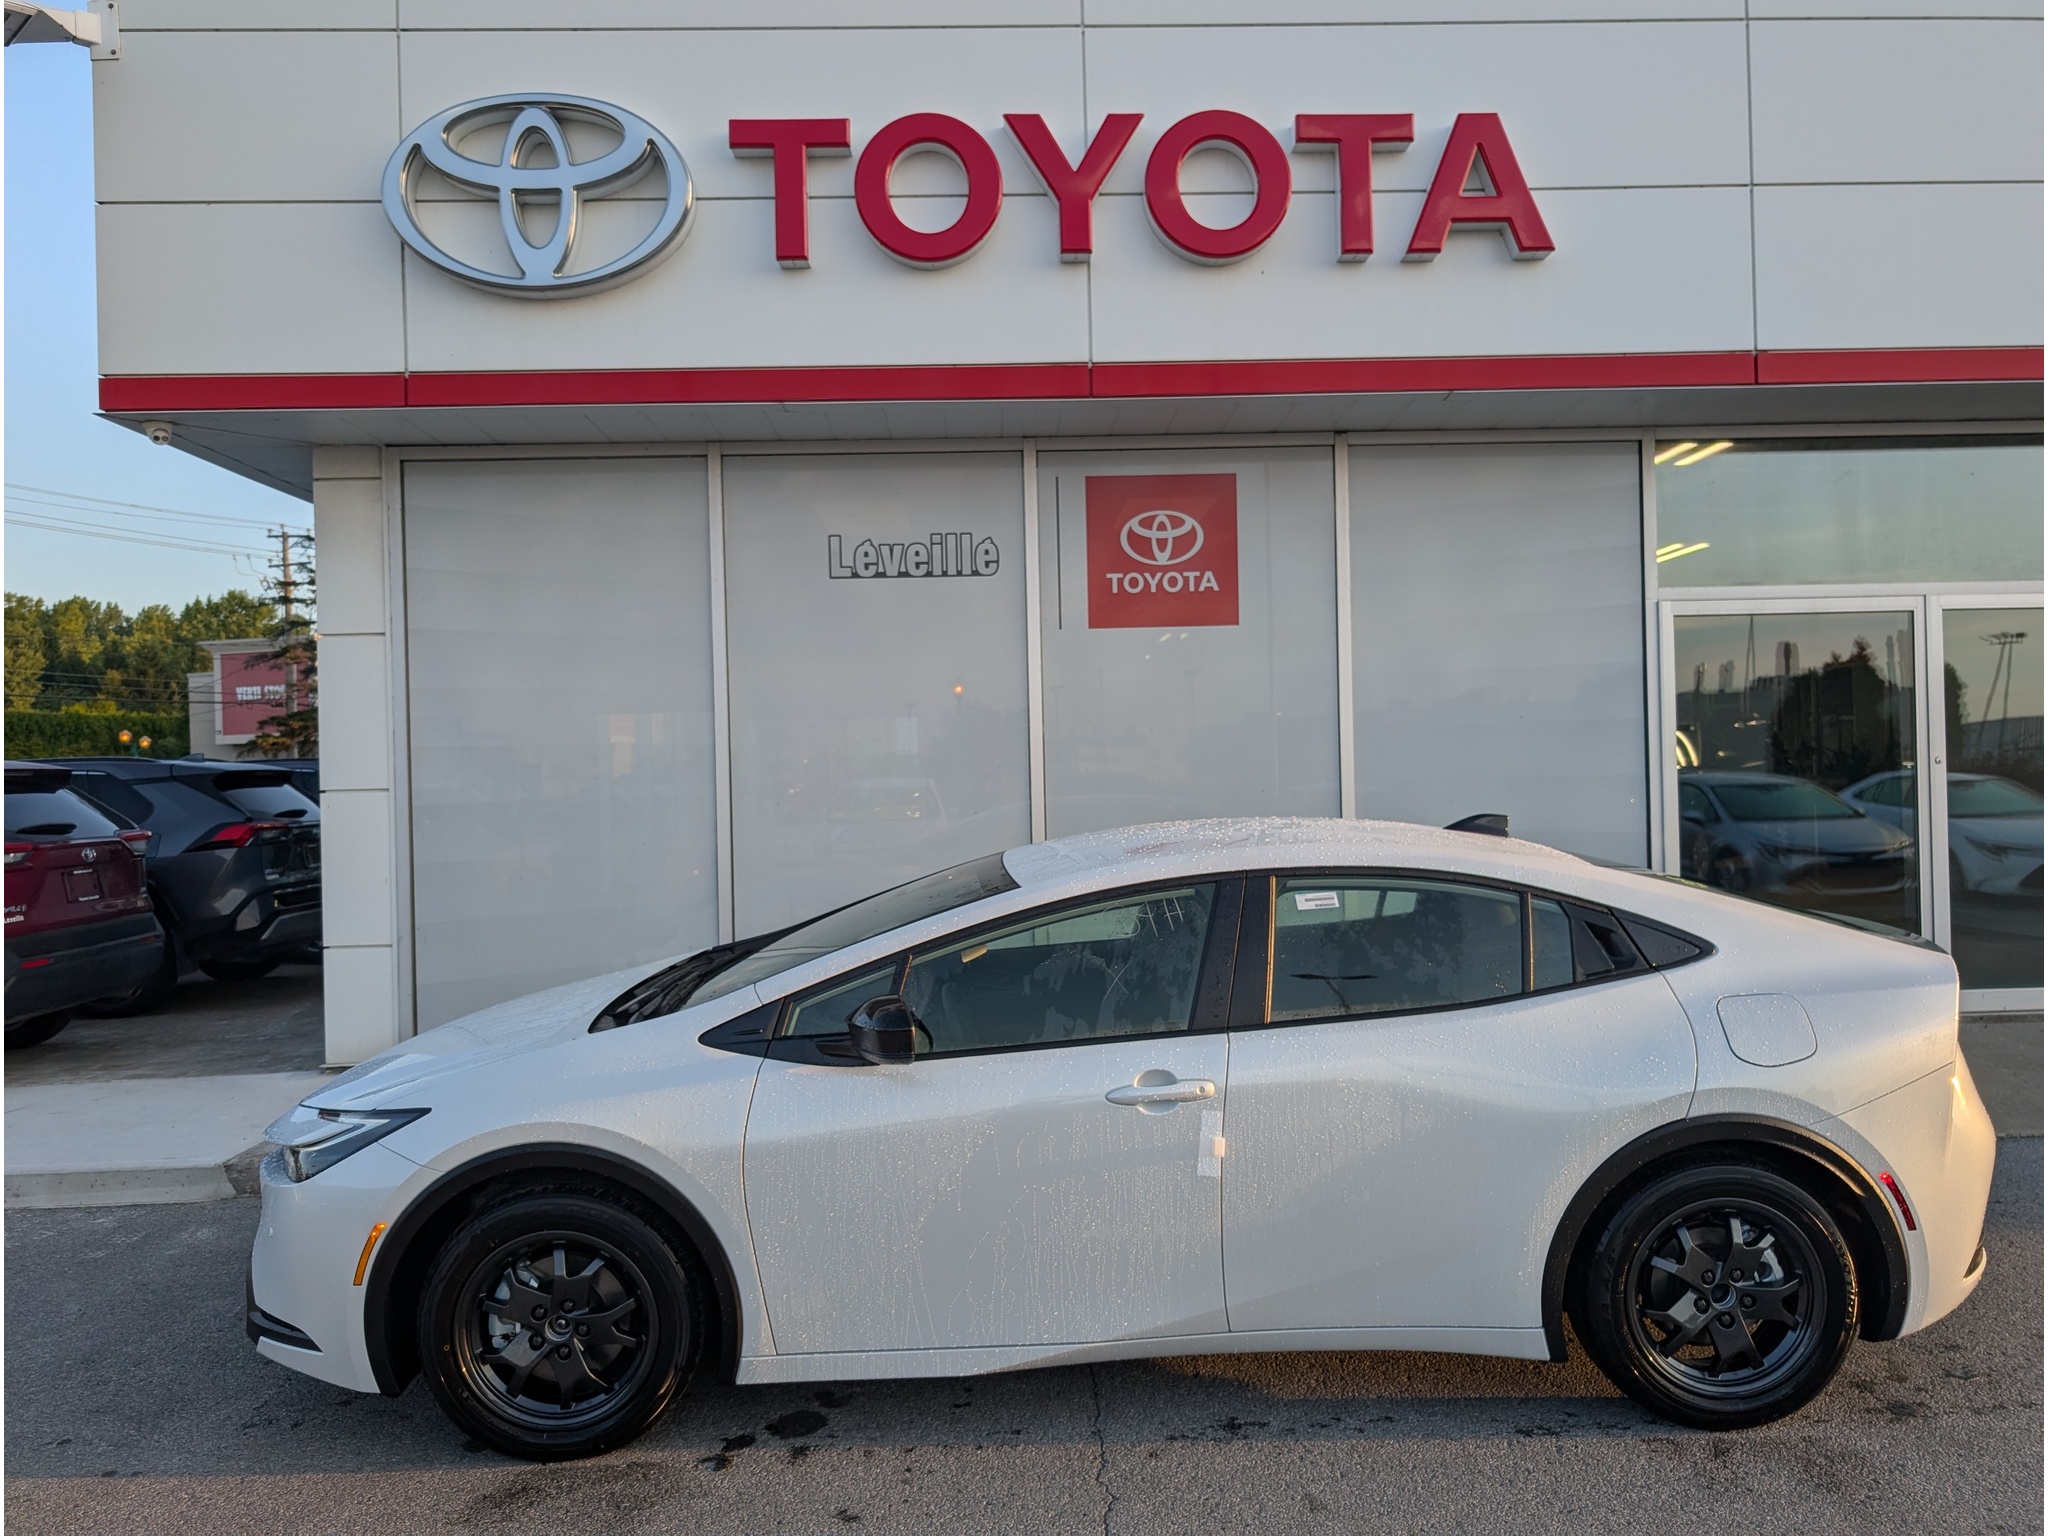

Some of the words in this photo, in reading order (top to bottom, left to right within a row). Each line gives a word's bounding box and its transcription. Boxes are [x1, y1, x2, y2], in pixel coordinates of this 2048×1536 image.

[729, 109, 1556, 268] TOYOTA
[828, 532, 1000, 579] Léveillé
[1106, 570, 1220, 594] TOYOTA
